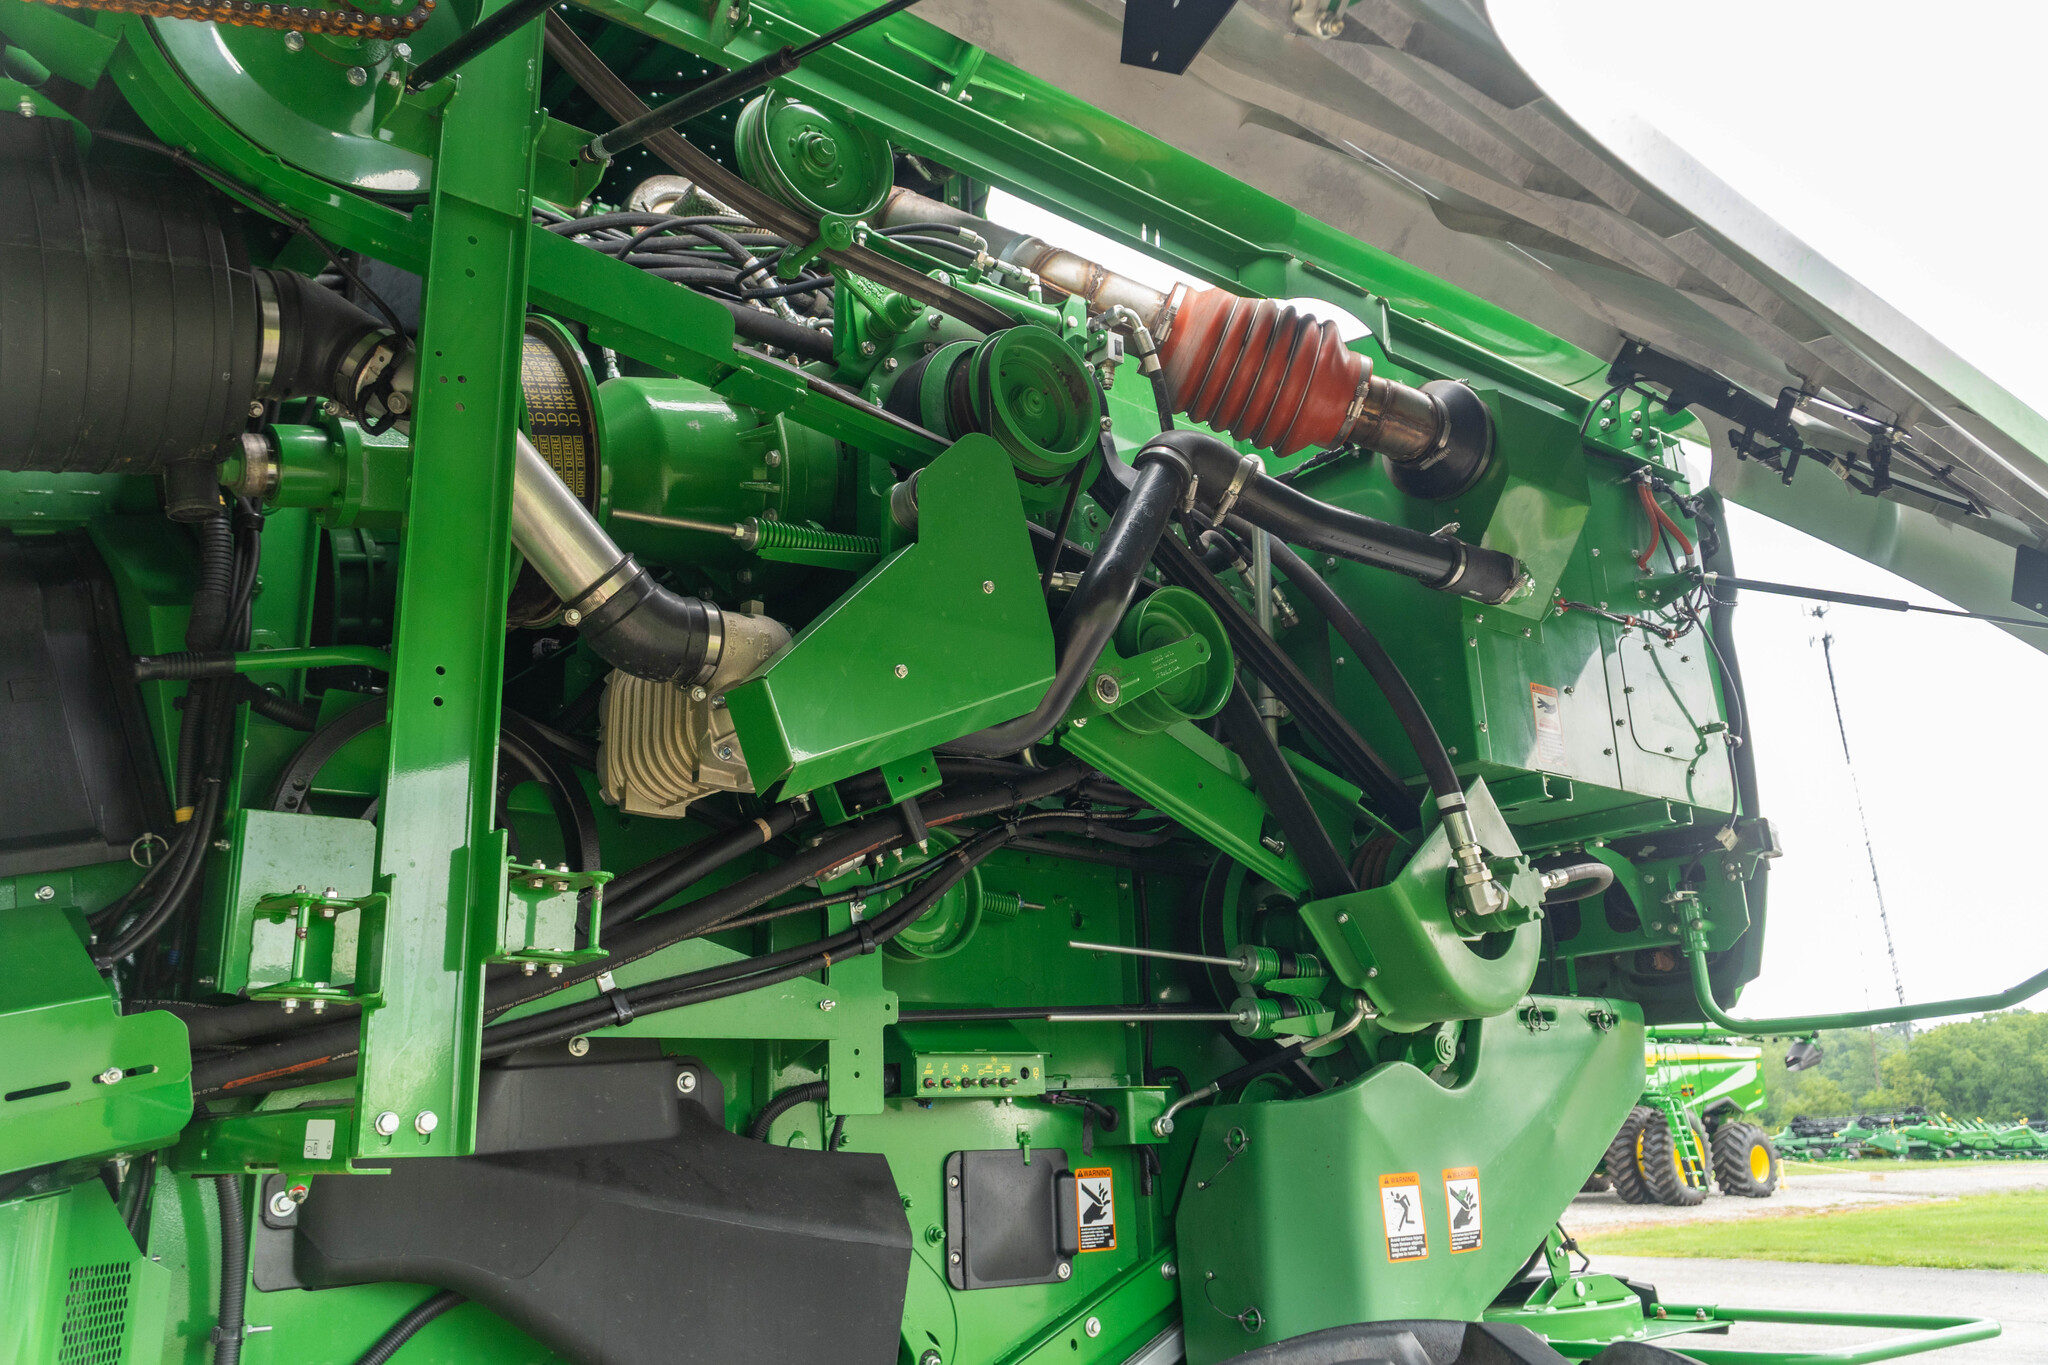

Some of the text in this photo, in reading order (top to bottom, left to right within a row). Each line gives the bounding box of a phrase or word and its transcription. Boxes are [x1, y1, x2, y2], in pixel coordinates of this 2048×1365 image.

[564, 437, 573, 468] DEERE
[575, 437, 584, 468] DEERE
[566, 471, 574, 490] OHN
[576, 471, 585, 497] JOHN
[1390, 1176, 1416, 1184] WARNING
